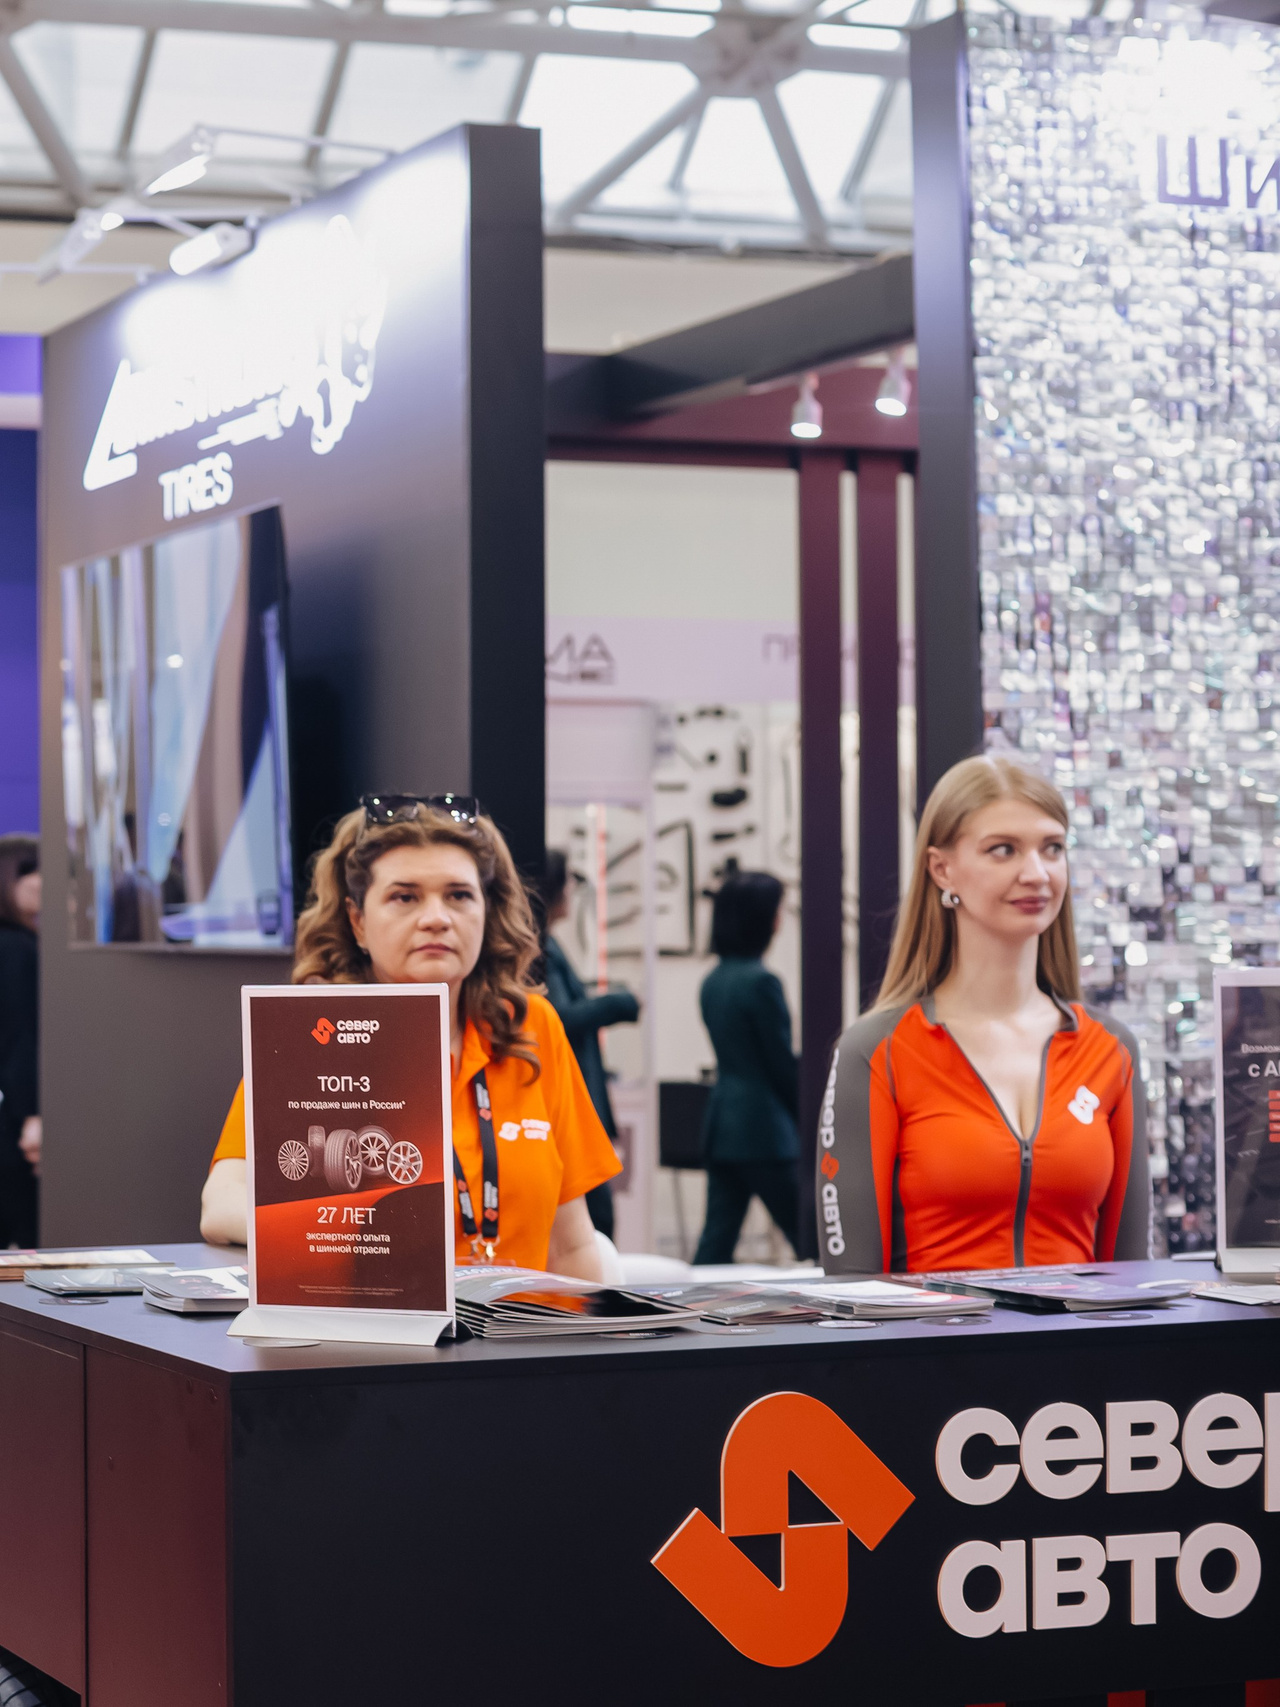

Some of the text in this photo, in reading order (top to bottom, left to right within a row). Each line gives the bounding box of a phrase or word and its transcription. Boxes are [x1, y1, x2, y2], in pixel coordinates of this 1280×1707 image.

[158, 452, 233, 521] TIRES
[336, 1019, 380, 1034] север
[336, 1032, 371, 1044] авто
[317, 1076, 371, 1092] ТОП-3
[288, 1101, 300, 1109] по
[301, 1101, 340, 1111] продаже
[341, 1101, 361, 1109] шин
[362, 1101, 368, 1109] в
[317, 1206, 376, 1224] 27 ЛЕТ
[822, 1183, 845, 1256] авто
[306, 1232, 391, 1242] экспертного опыта
[309, 1244, 390, 1256] в шинной отрасли
[935, 1391, 1280, 1513] севе
[937, 1522, 1262, 1639] авто
